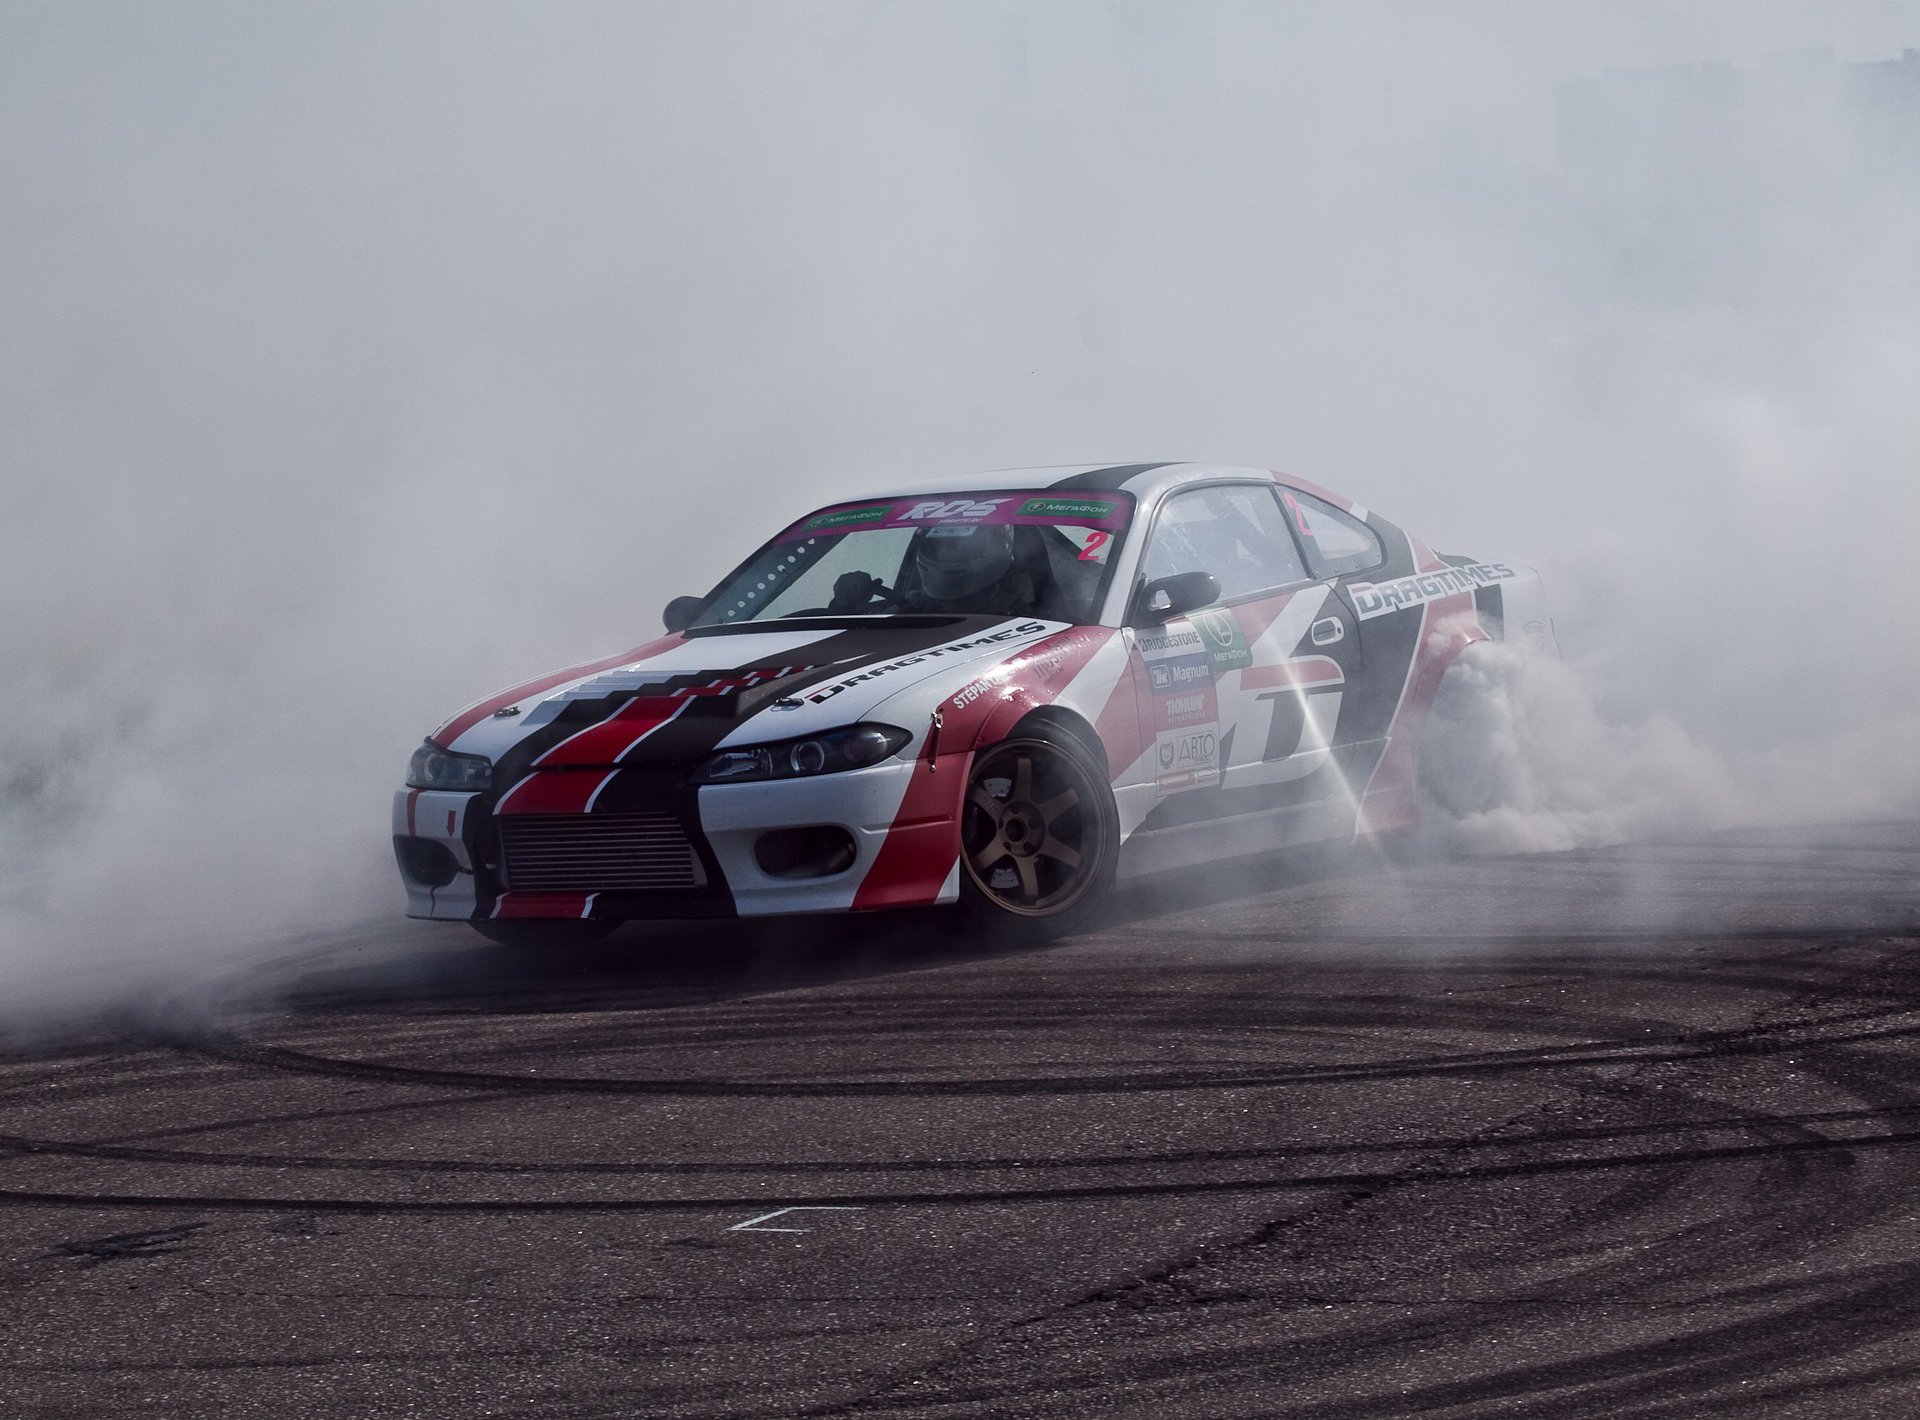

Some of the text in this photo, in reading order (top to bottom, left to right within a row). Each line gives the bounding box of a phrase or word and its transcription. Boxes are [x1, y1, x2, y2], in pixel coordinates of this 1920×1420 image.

[896, 499, 1014, 520] RDS
[1077, 532, 1109, 561] 2
[1350, 564, 1516, 614] DRAGTIMES
[1138, 631, 1201, 652] BRIDGESTONE
[804, 621, 1047, 704] DRAGTIMES
[1173, 665, 1209, 682] Magnum
